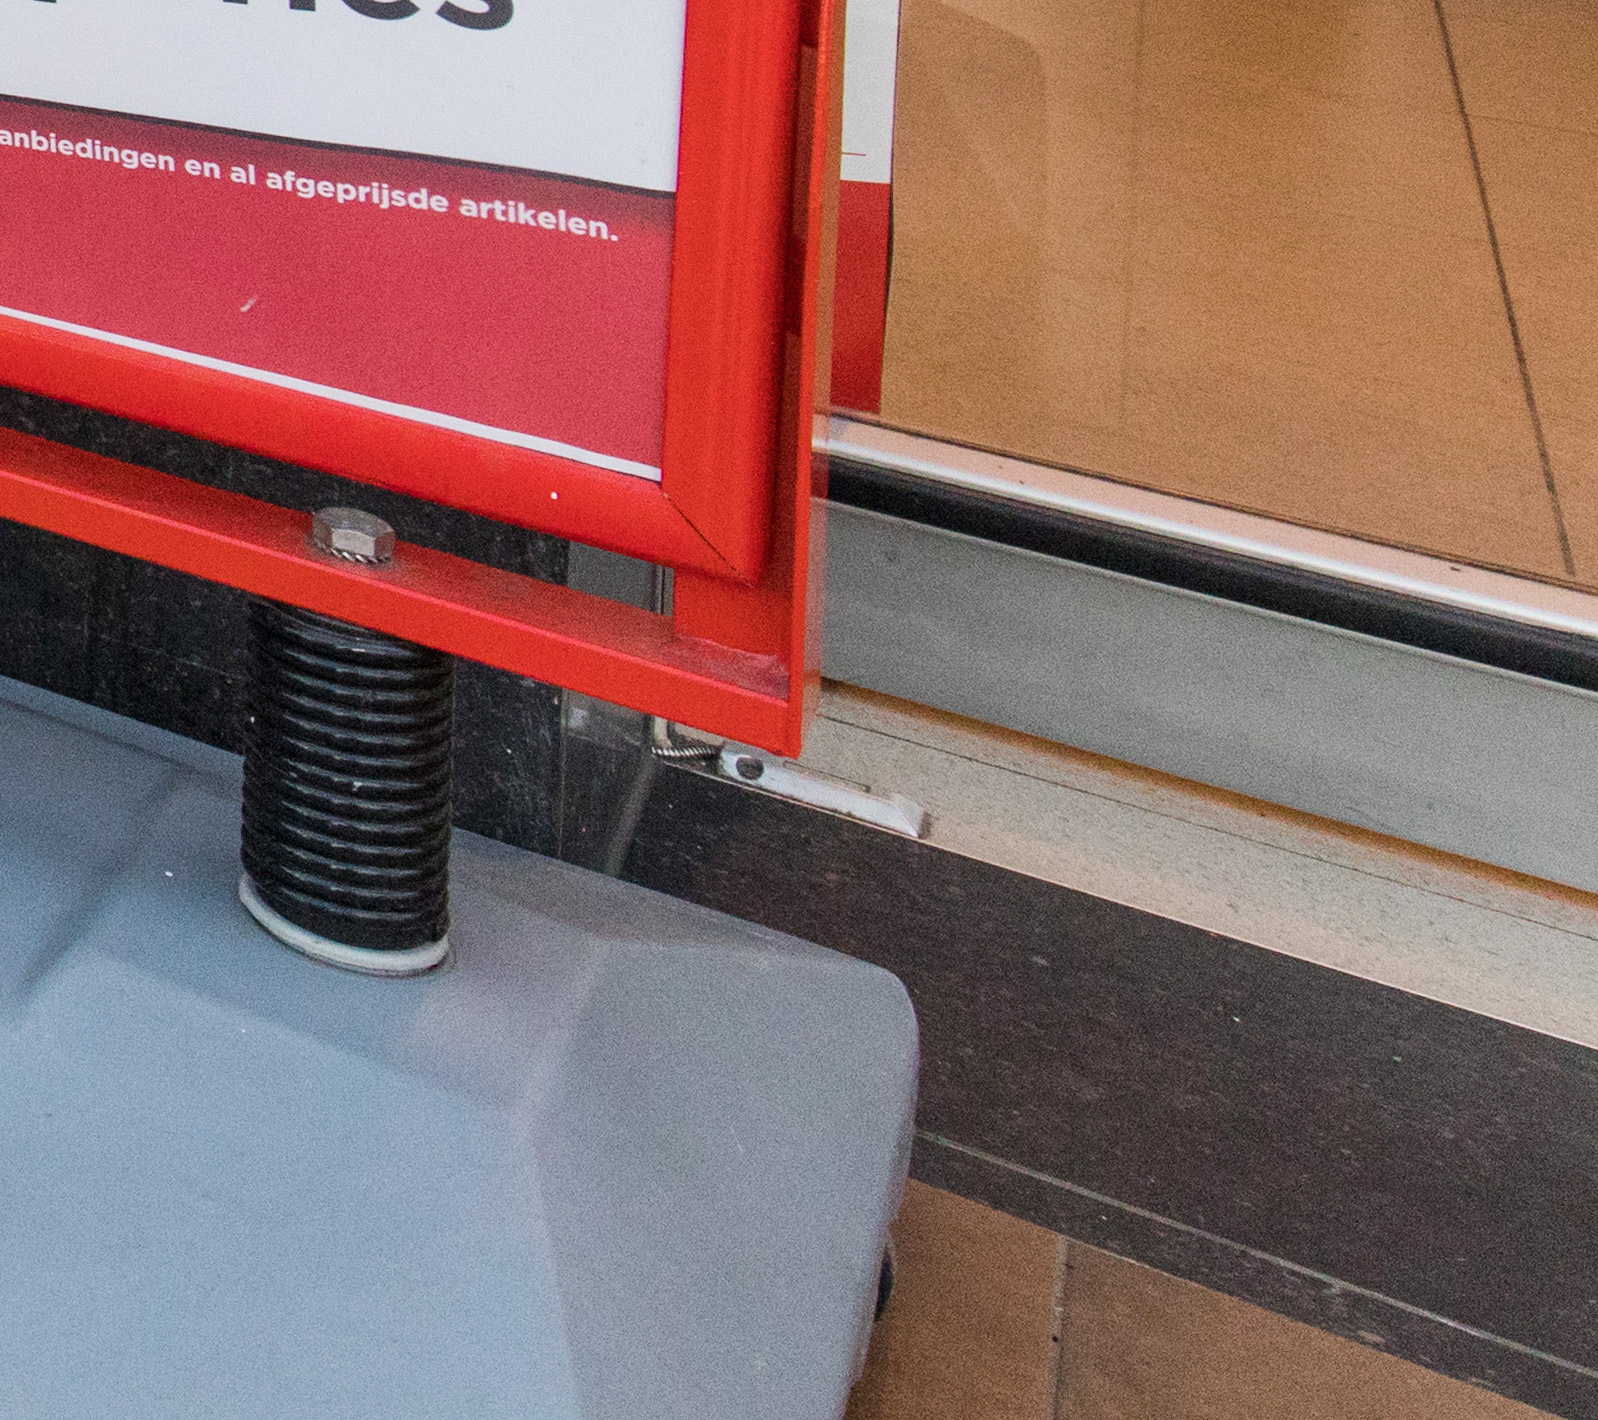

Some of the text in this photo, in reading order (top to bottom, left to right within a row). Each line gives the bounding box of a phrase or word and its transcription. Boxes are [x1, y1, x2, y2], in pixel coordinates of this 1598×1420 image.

[184, 156, 222, 180] en
[230, 162, 256, 186] al
[265, 169, 450, 212] afgeprijsde
[459, 197, 619, 242] artikelen.
